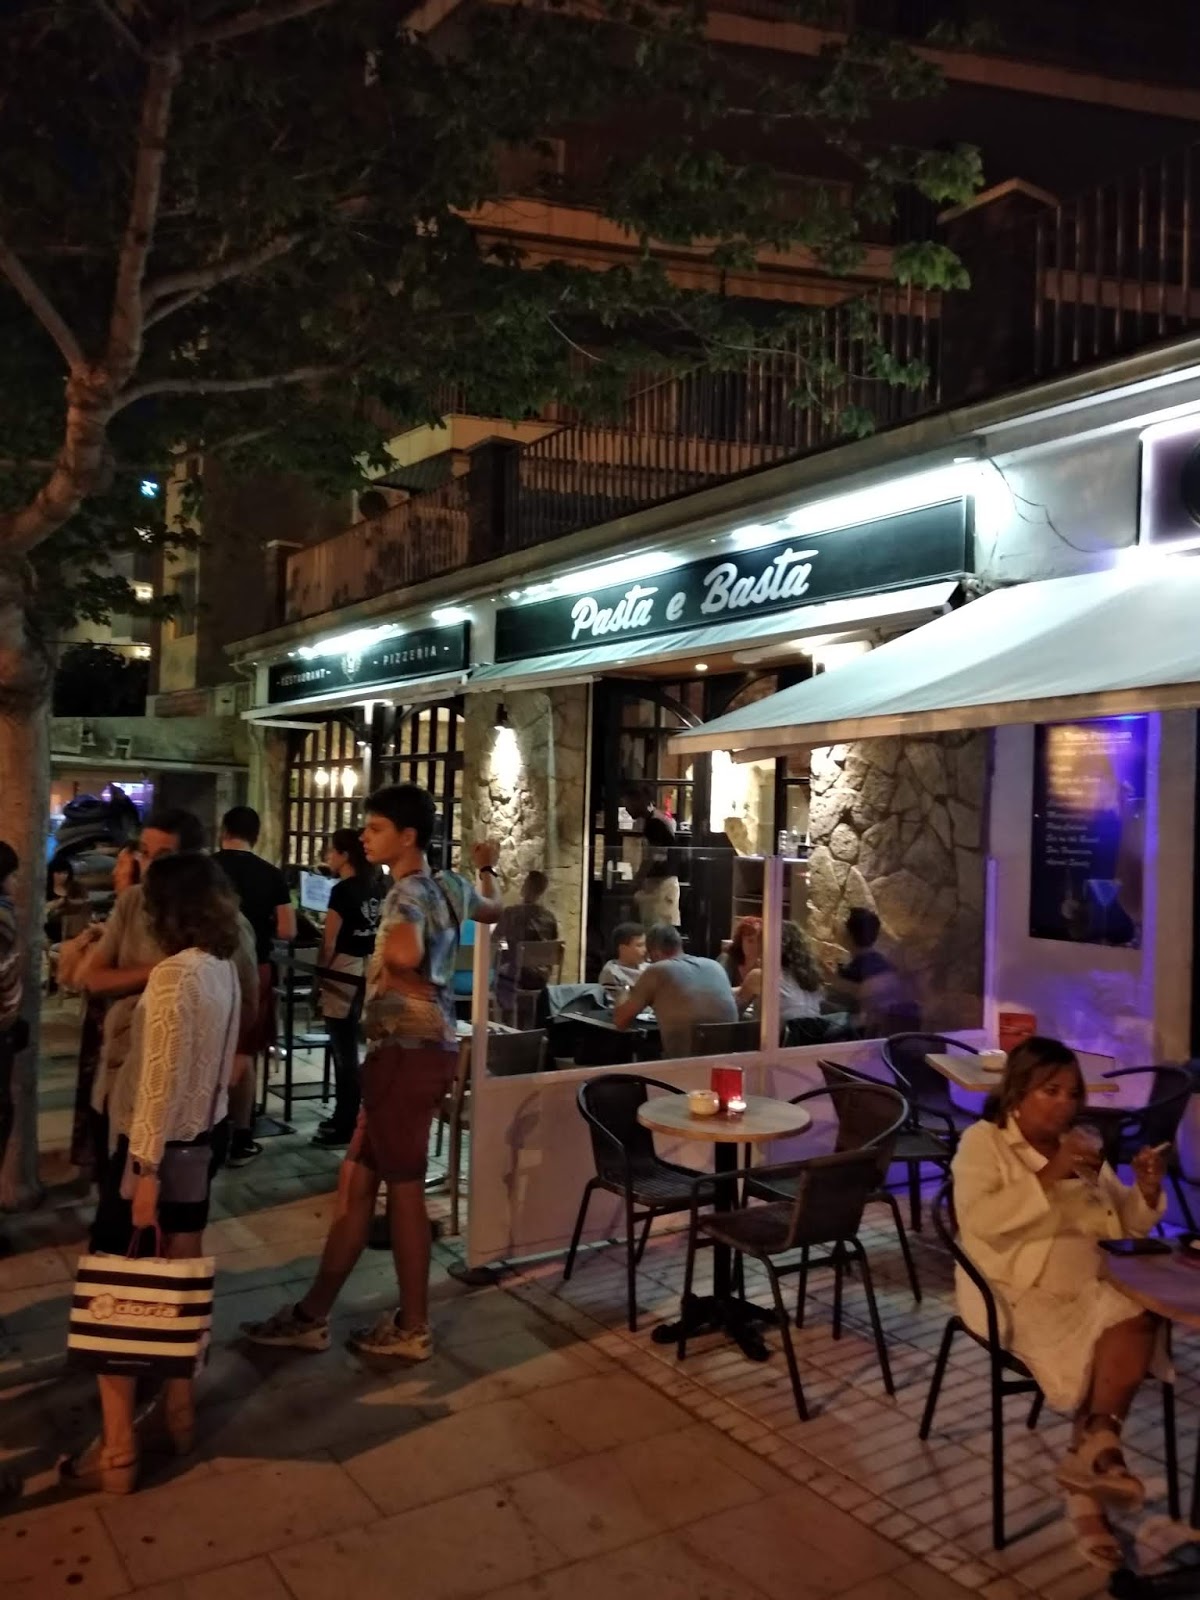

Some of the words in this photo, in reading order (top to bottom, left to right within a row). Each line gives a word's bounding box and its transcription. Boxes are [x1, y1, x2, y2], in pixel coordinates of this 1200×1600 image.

[570, 584, 659, 640] Pasta
[665, 591, 687, 621] e
[700, 547, 819, 614] Basta
[383, 645, 437, 666] PIZZERIA
